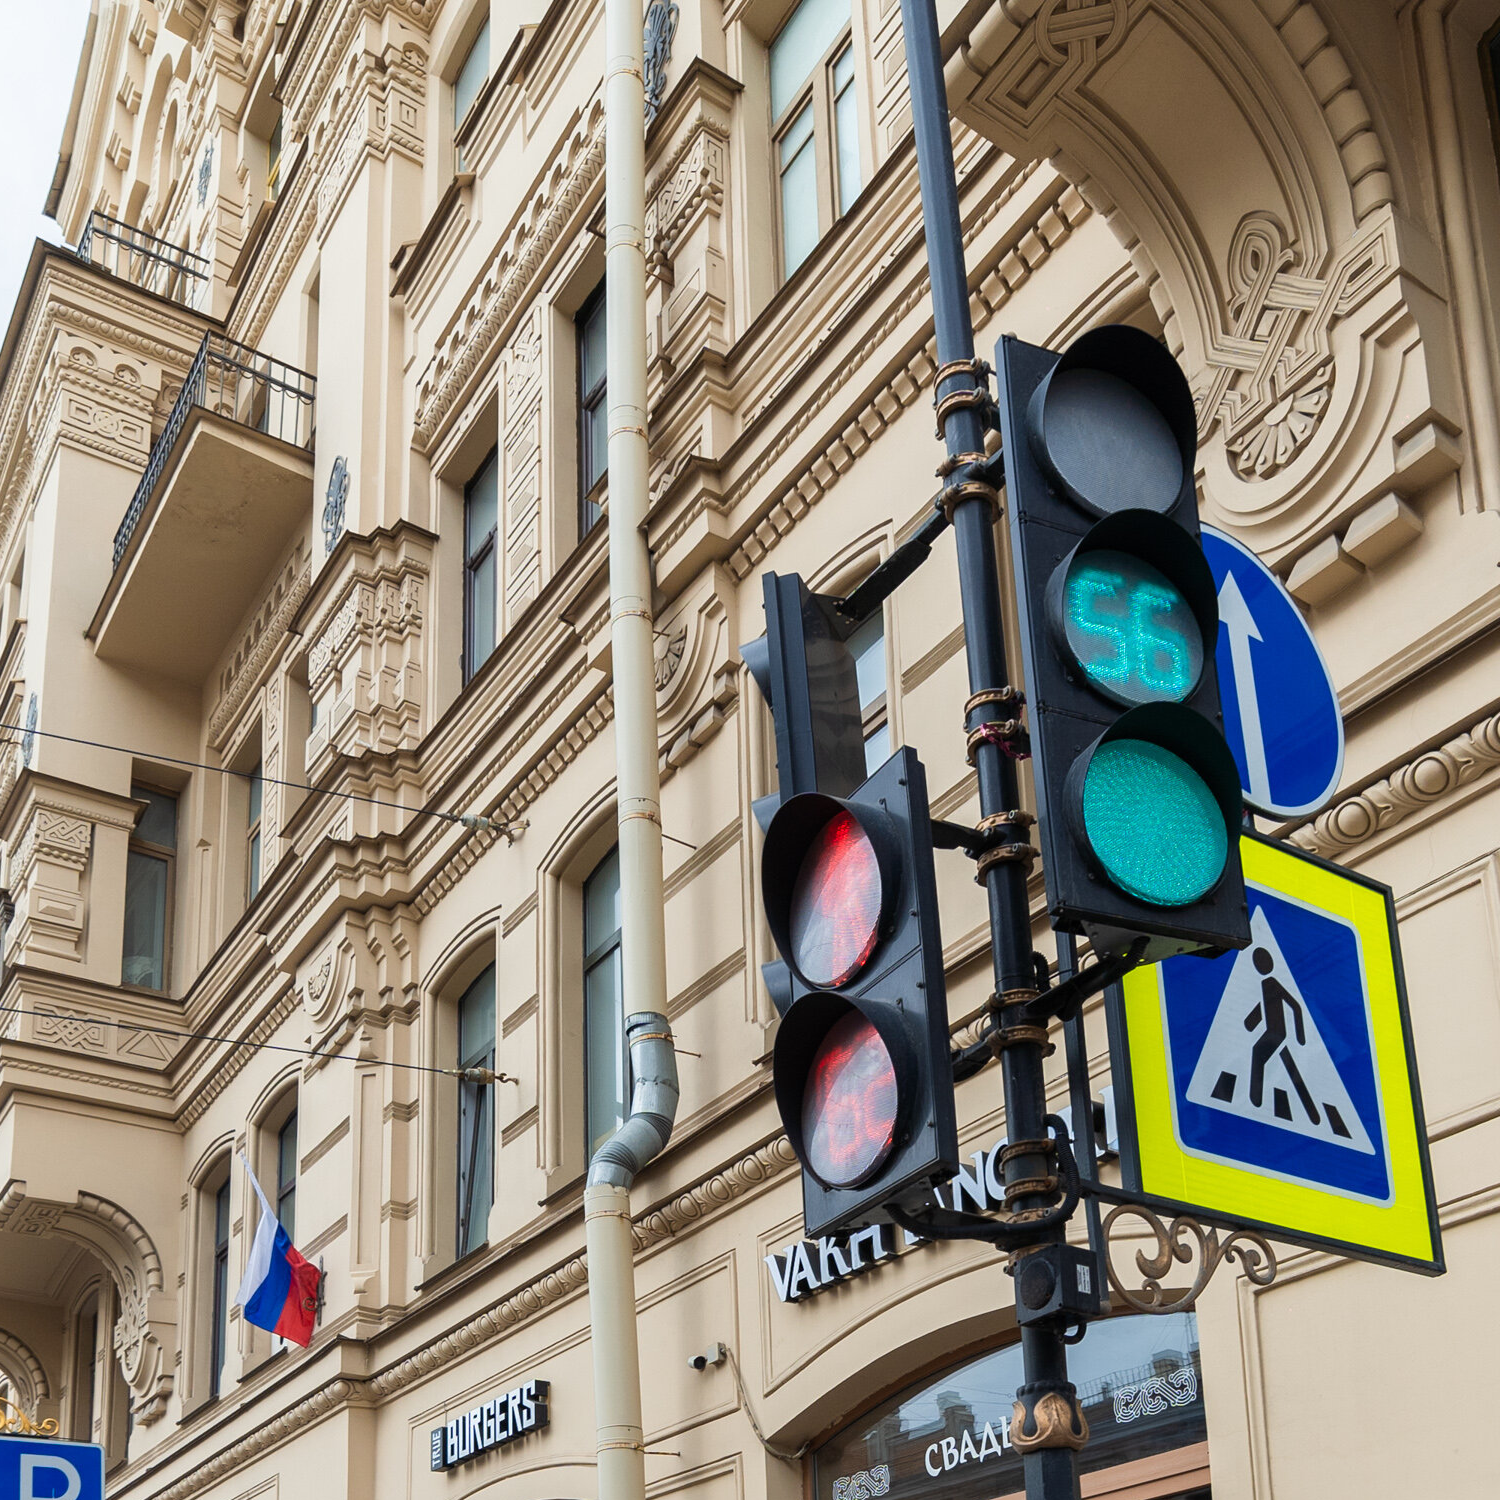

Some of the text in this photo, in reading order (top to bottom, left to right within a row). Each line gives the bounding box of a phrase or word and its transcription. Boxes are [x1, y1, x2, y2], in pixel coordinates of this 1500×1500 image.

[1069, 567, 1191, 695] 56
[431, 1431, 441, 1468] TRUE
[447, 1379, 536, 1465] BURGERS
